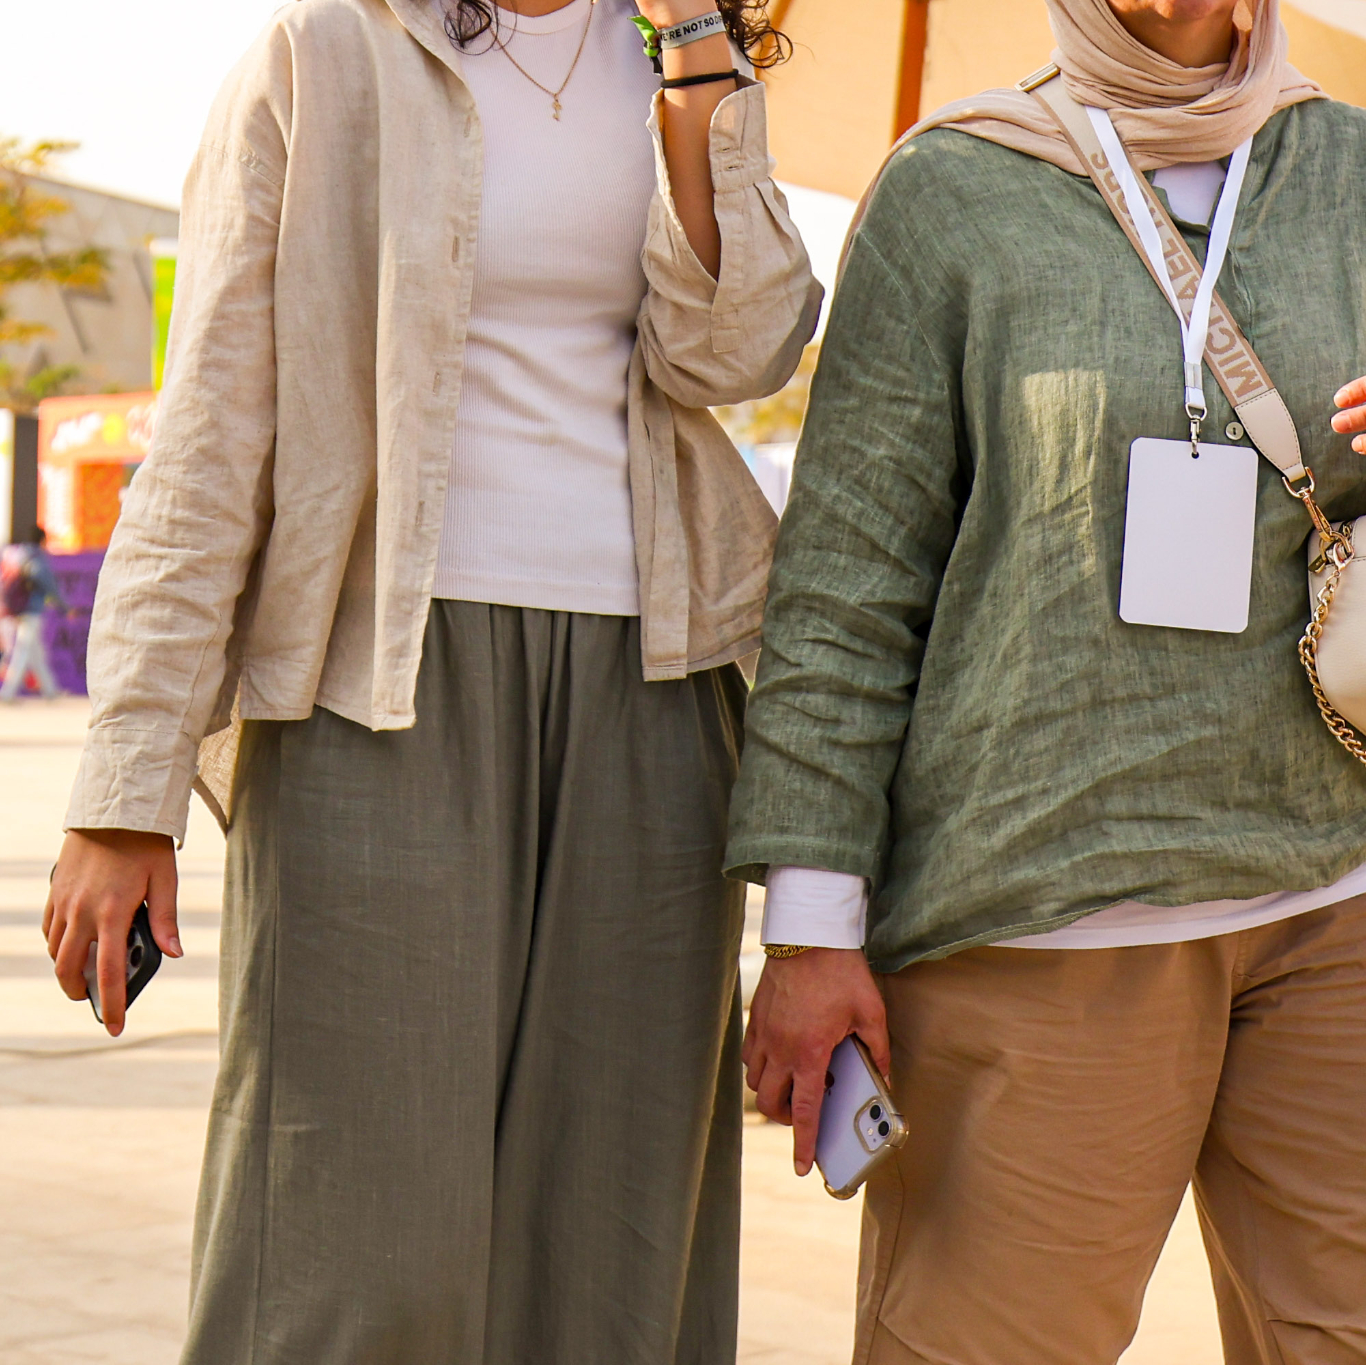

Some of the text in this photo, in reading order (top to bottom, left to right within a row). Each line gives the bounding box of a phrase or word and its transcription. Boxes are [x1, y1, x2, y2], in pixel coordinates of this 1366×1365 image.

[683, 20, 703, 35] NOT
[703, 17, 715, 28] SO
[1161, 236, 1264, 400] MICAEL
